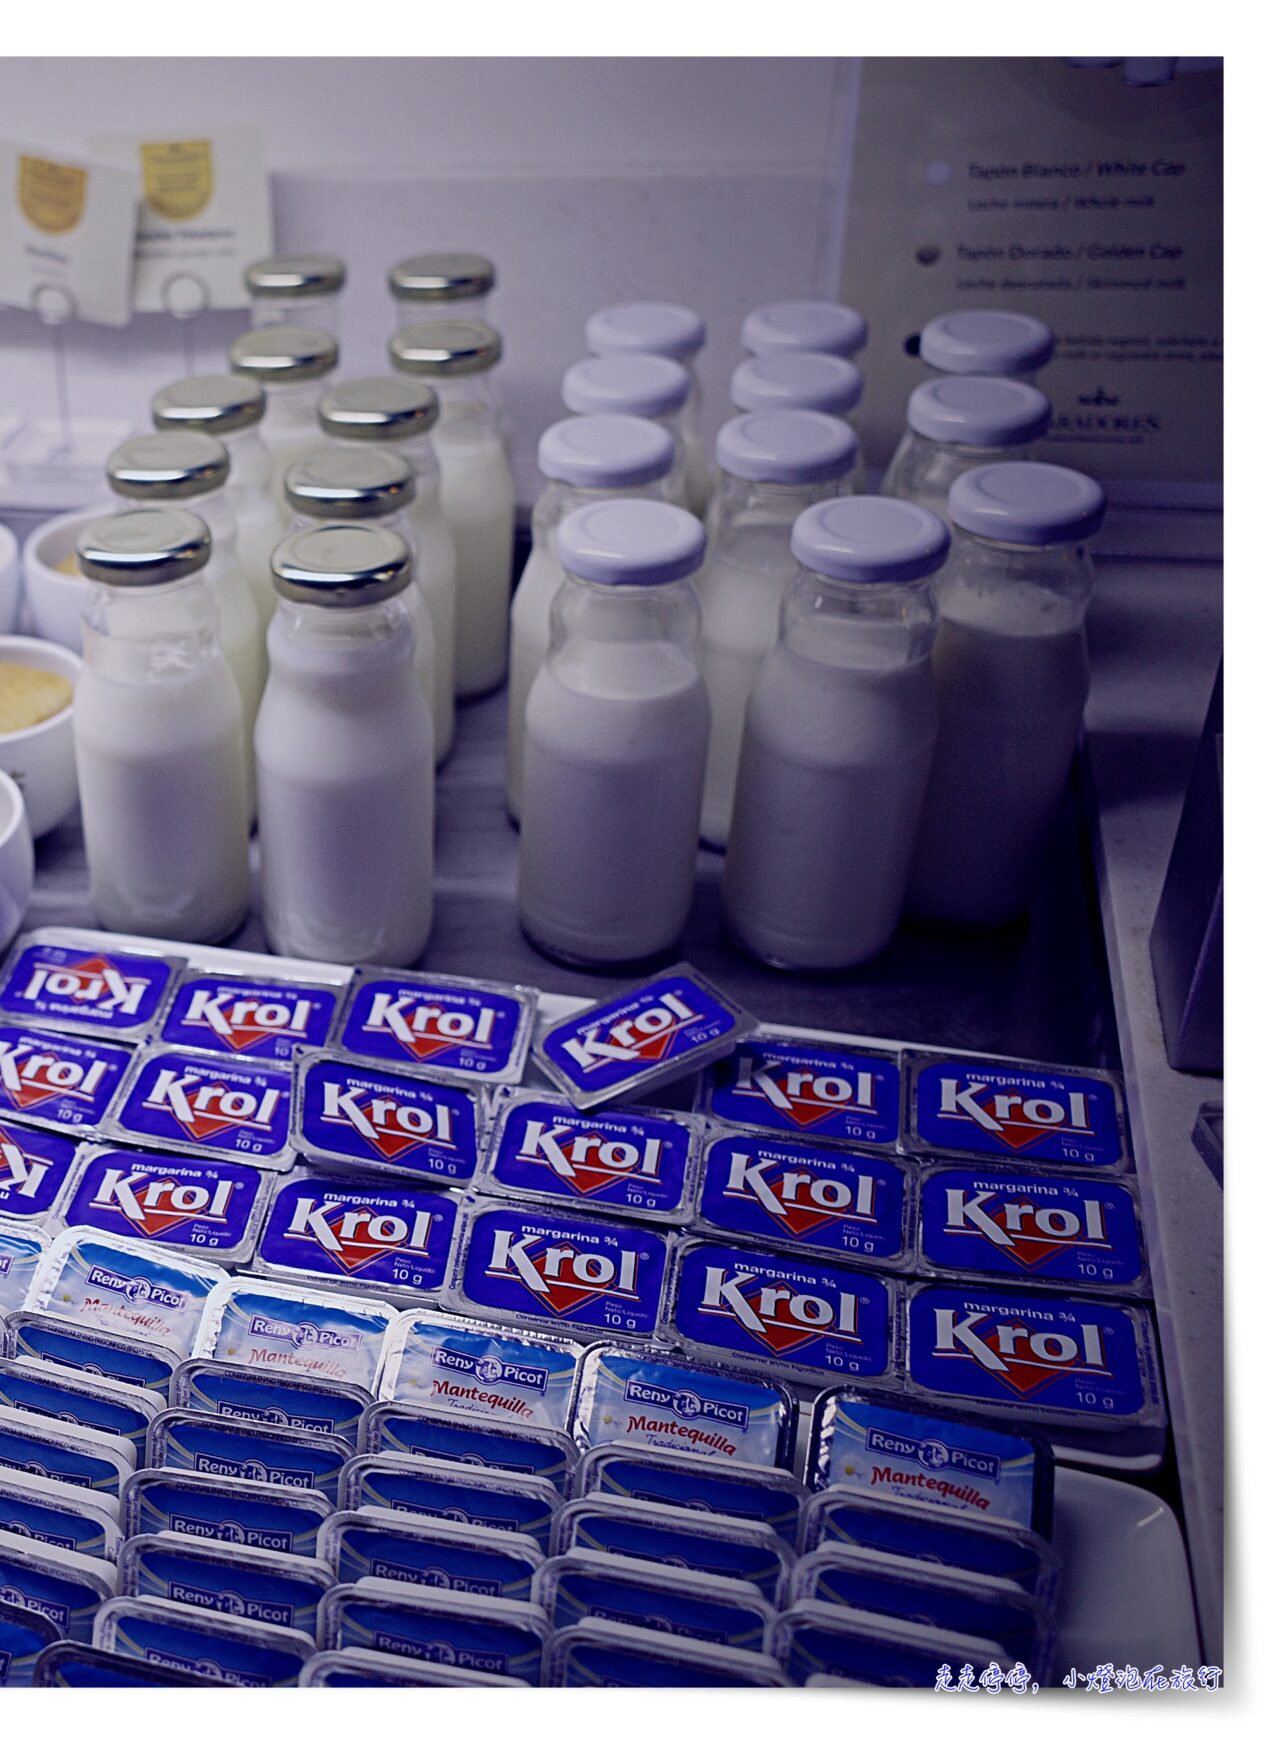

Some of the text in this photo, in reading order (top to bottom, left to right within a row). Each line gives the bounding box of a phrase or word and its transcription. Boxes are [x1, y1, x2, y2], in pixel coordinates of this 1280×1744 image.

[23, 968, 145, 1013] Krol
[398, 989, 465, 1004] margarina
[185, 991, 310, 1034] Krol
[367, 994, 494, 1042] Krol
[560, 993, 694, 1067] Krol
[691, 1032, 709, 1042] 10
[18, 1038, 82, 1056] margarina
[184, 1066, 252, 1084] margarina
[460, 1057, 485, 1070] 10 g
[346, 1078, 417, 1099] margarina
[737, 1057, 872, 1108] Krol
[965, 1074, 1047, 1089] margarina
[148, 1070, 280, 1122] Krol
[938, 1079, 1087, 1131] Krol
[57, 1108, 82, 1123] 10 g
[323, 1080, 451, 1140] Krol
[553, 1116, 627, 1133] margarina
[847, 1125, 876, 1140] 10 g
[236, 1138, 261, 1152] 10 g
[520, 1120, 660, 1175] Krol
[1063, 1148, 1095, 1162] 10 g
[131, 1165, 202, 1177] margarina
[429, 1158, 456, 1174] 10 g
[757, 1150, 837, 1171] margarina
[94, 1169, 232, 1218] Krol
[726, 1153, 873, 1215] Krol
[972, 1181, 1060, 1196] margarina
[324, 1193, 397, 1207] margarina
[627, 1193, 655, 1208] 10 g
[288, 1198, 430, 1251] Krol
[943, 1188, 1105, 1246] Krol
[191, 1233, 218, 1246] 10 g
[521, 1225, 600, 1244] margarina
[843, 1235, 874, 1253] 10 g
[489, 1229, 635, 1292] Krol
[1079, 1263, 1114, 1279] 10 g
[393, 1269, 422, 1284] 10 g
[734, 1262, 817, 1285] margarina
[91, 1268, 185, 1307] Reny Picot
[702, 1266, 855, 1333] Krol
[962, 1302, 1055, 1320] margarina
[81, 1298, 171, 1336] Mantequilla
[254, 1320, 291, 1335] Reny
[606, 1312, 636, 1330] 10 g
[932, 1308, 1104, 1371] Krol
[249, 1349, 346, 1378] Mantequilla
[434, 1352, 543, 1385] Reny Picot
[827, 1354, 859, 1373] 10 g
[431, 1380, 533, 1420] Mantequilla
[629, 1385, 744, 1423] Reny Picot
[1077, 1392, 1115, 1409] 10 g
[290, 1418, 329, 1432] Picot
[627, 1416, 736, 1456] Mantequilla
[872, 1432, 994, 1473] Reny Picot
[199, 1458, 311, 1488] Reny Picot
[871, 1467, 990, 1510] Mantequilla
[174, 1519, 288, 1548] Reny Picot
[376, 1564, 495, 1595] Reny Picot
[29, 1599, 65, 1621] Picot
[173, 1587, 289, 1622] Reny Picot
[379, 1635, 504, 1671] Reny Picot
